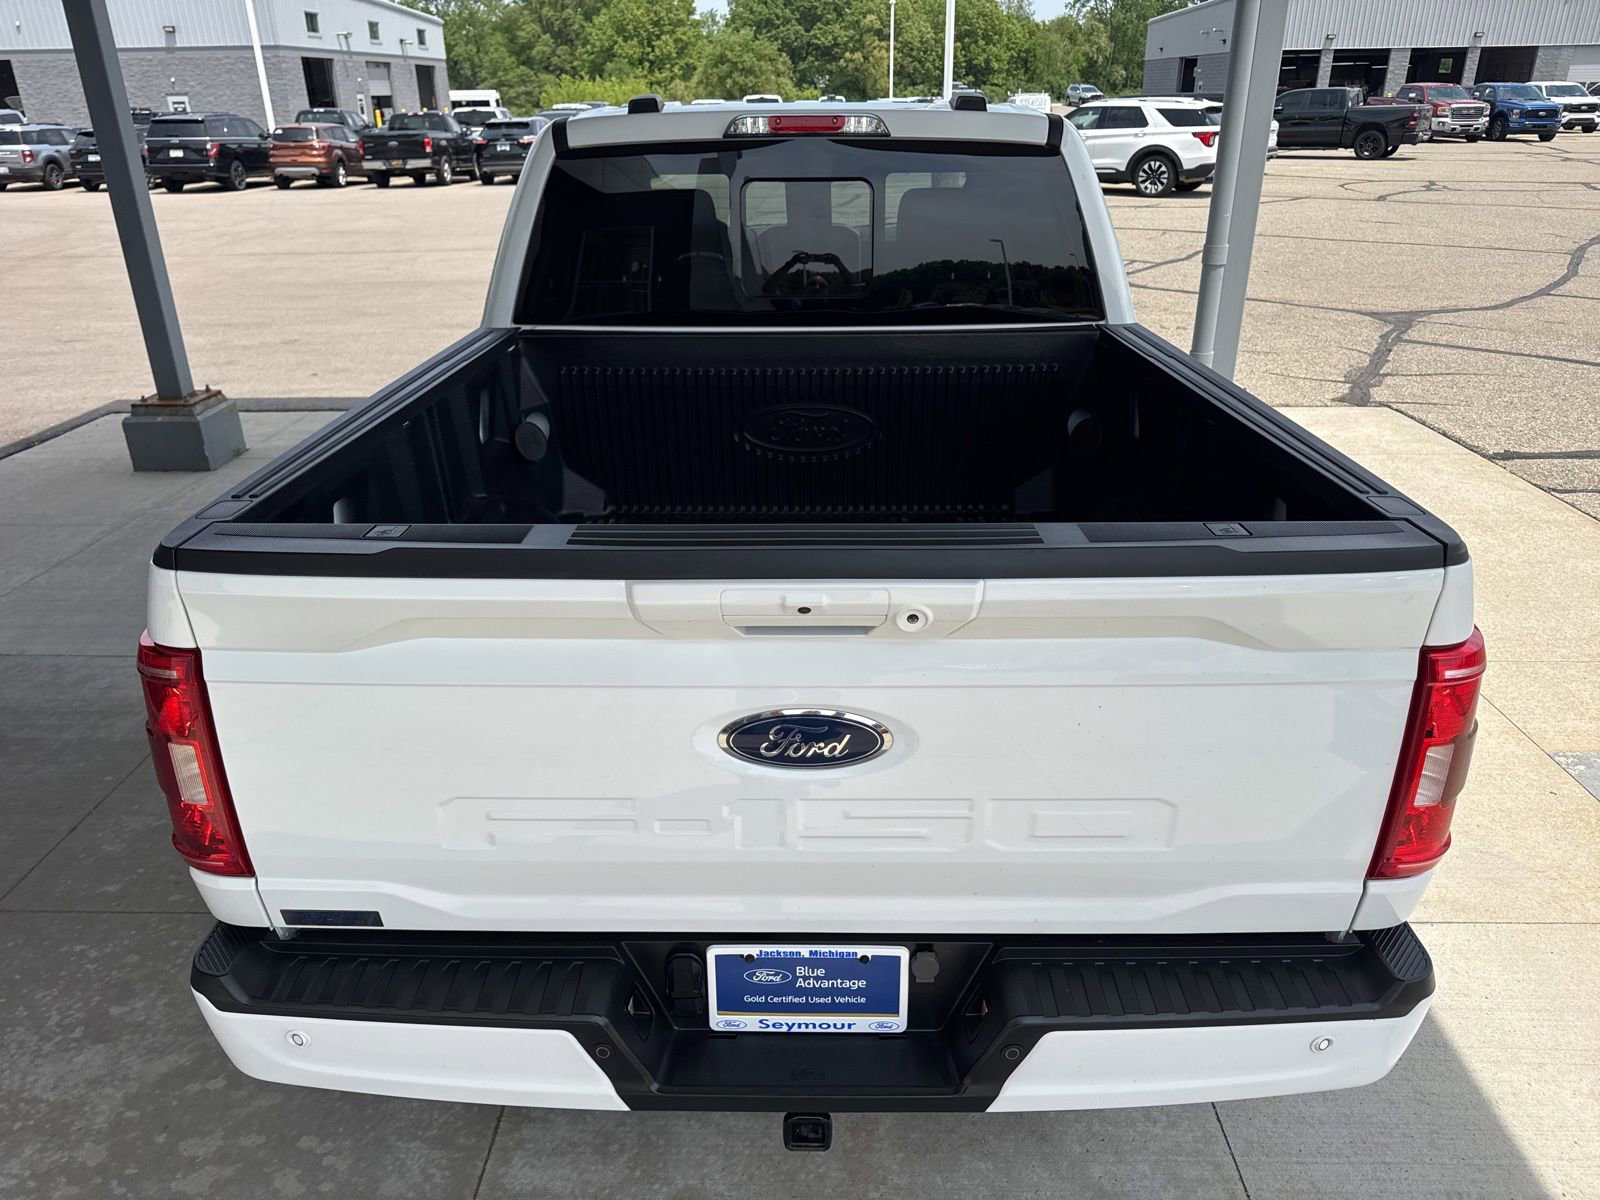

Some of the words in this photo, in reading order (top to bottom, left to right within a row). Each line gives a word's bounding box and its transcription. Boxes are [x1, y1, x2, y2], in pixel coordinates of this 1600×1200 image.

[760, 724, 851, 758] Ford
[437, 797, 1178, 851] F-150
[809, 950, 858, 959] Michigan
[752, 970, 783, 982] Ford
[796, 966, 826, 977] Blue
[795, 978, 867, 990] Advantage
[743, 995, 766, 1003] Gold
[767, 995, 806, 1004] Certified
[808, 996, 832, 1004] Used
[834, 996, 867, 1004] Vehicle
[758, 1018, 857, 1032] Seymour
